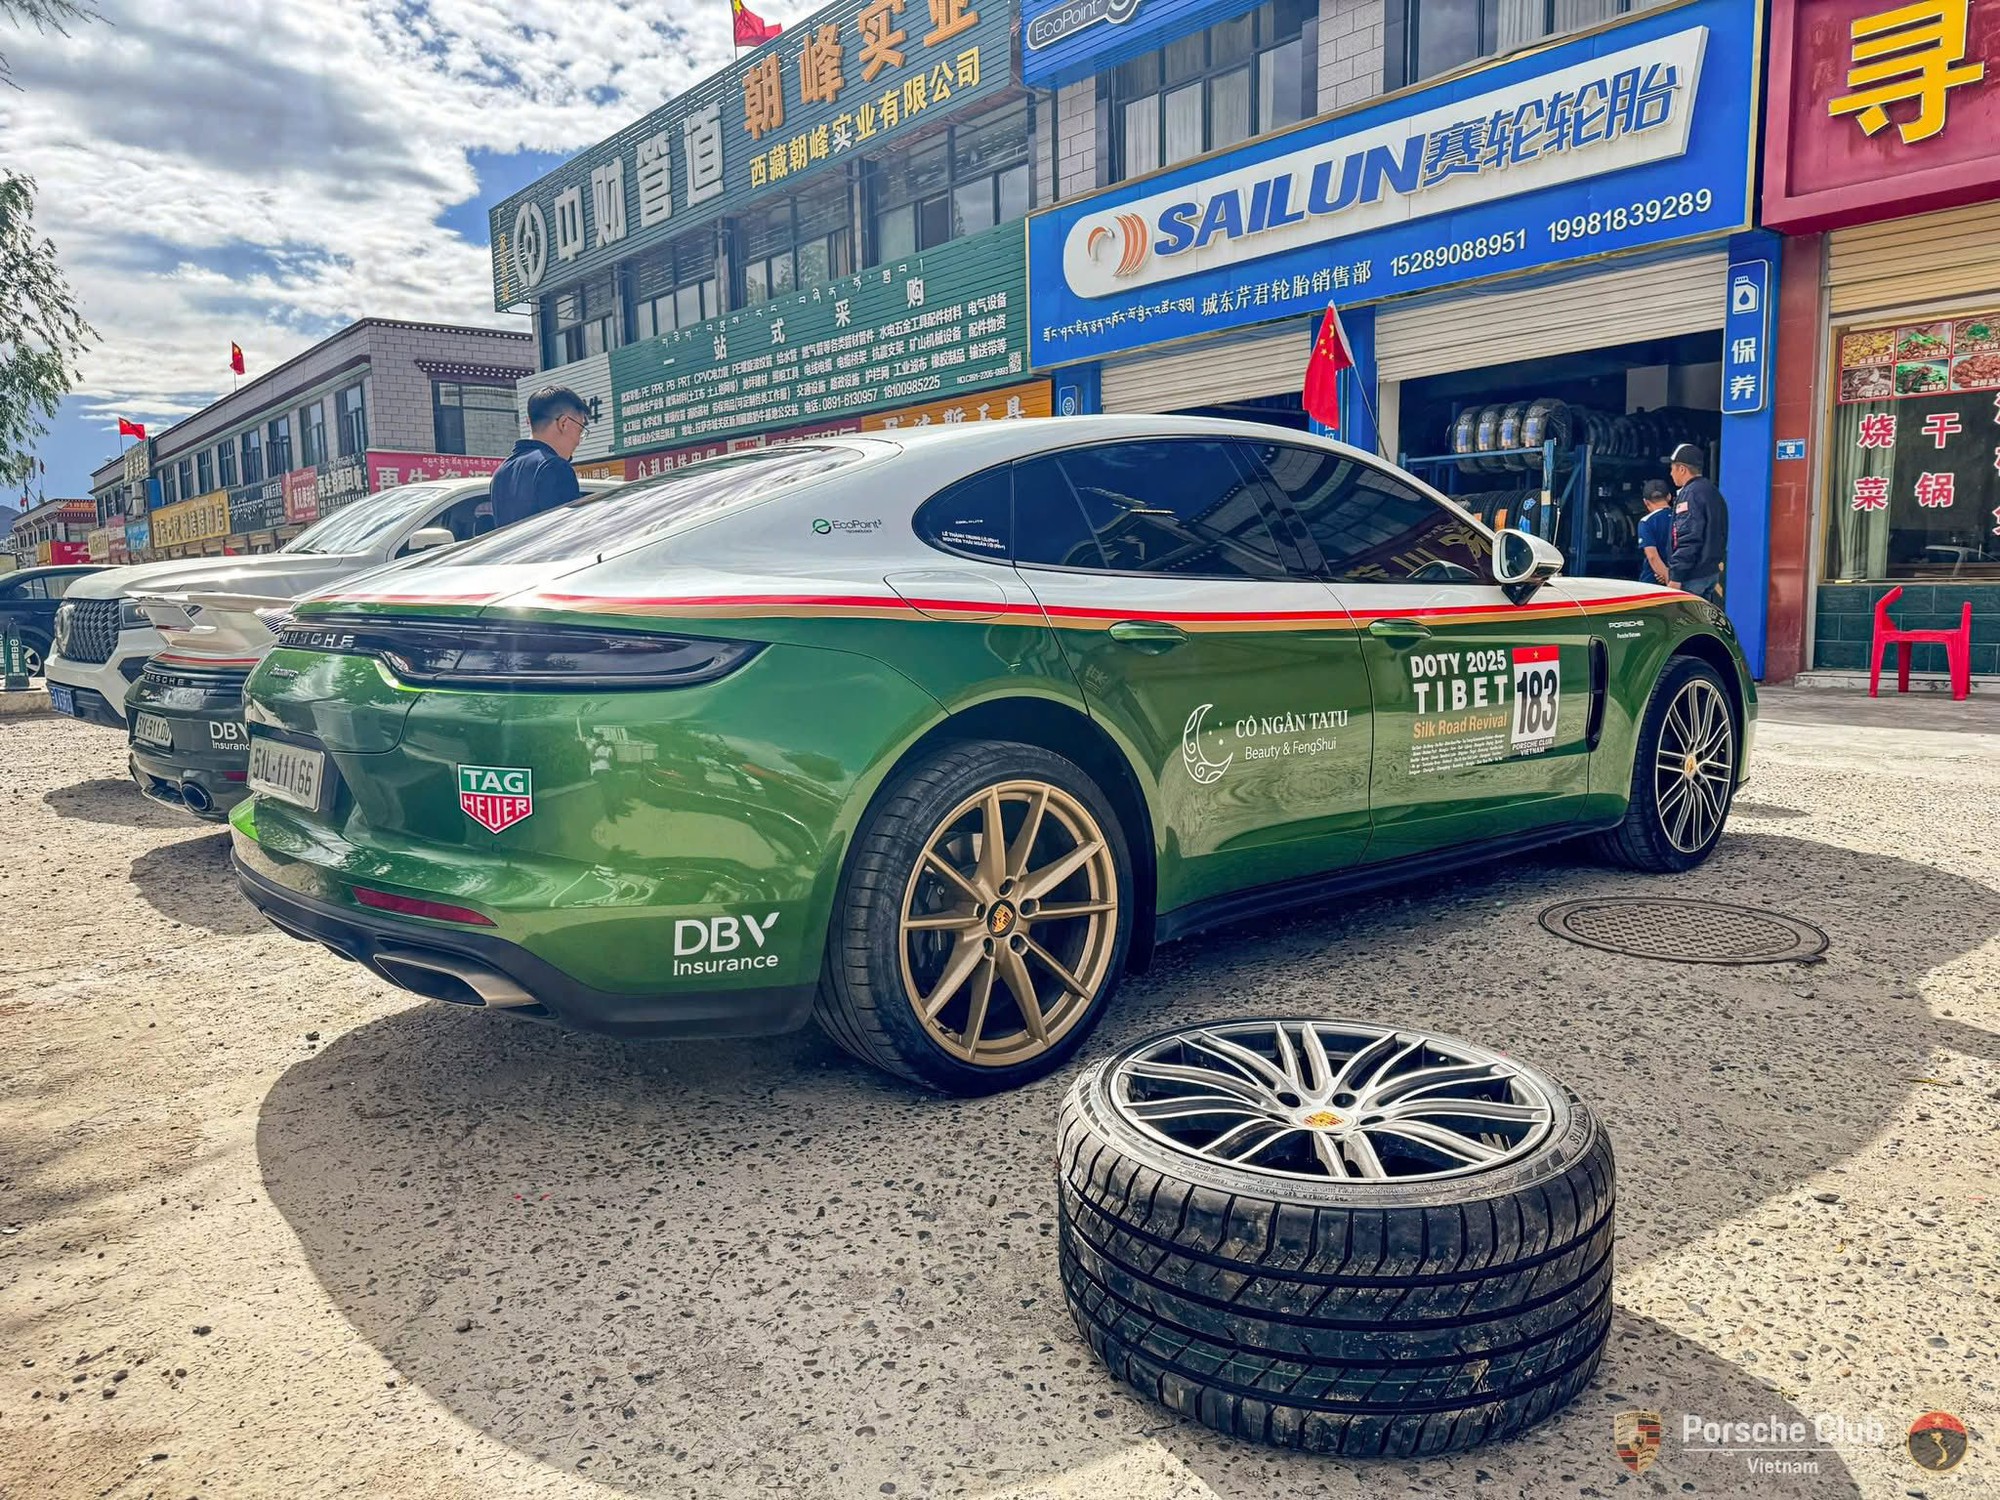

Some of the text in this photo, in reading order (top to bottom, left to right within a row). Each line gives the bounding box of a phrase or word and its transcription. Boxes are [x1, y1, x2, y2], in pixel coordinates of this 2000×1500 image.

[742, 0, 980, 139] 朝峰实业
[749, 46, 981, 188] 西藏朝峰实业有限公司
[1154, 61, 1679, 257] SAILUN 赛轮轮胎
[1201, 187, 1713, 316] 城东芹君轮胎销售部 15289088951 19981839289
[967, 292, 1007, 316] 电气设备
[909, 326, 962, 352] 矿山机械设备
[968, 314, 1007, 338] 配件物资
[1730, 336, 1756, 400] 保养
[883, 375, 941, 400] 18100985225
[1852, 414, 1896, 511] 烧菜
[1915, 412, 1963, 508] 干锅
[1410, 649, 1507, 678] DOTY 2025
[1413, 675, 1508, 715] TIBET
[1516, 669, 1558, 735] 183
[1235, 709, 1349, 738] CÔ NGÂN TATU
[1413, 711, 1508, 739] Silk Road Revival
[212, 739, 250, 751] Insuranc
[1245, 736, 1337, 760] Beauty & FengShui
[1512, 738, 1538, 751] PORSCHE
[1520, 747, 1545, 757] VIETNAM
[252, 747, 314, 796] 51L-111.66
[463, 769, 524, 793] TAG
[463, 795, 528, 829] HEUER
[673, 954, 779, 976] Insurance
